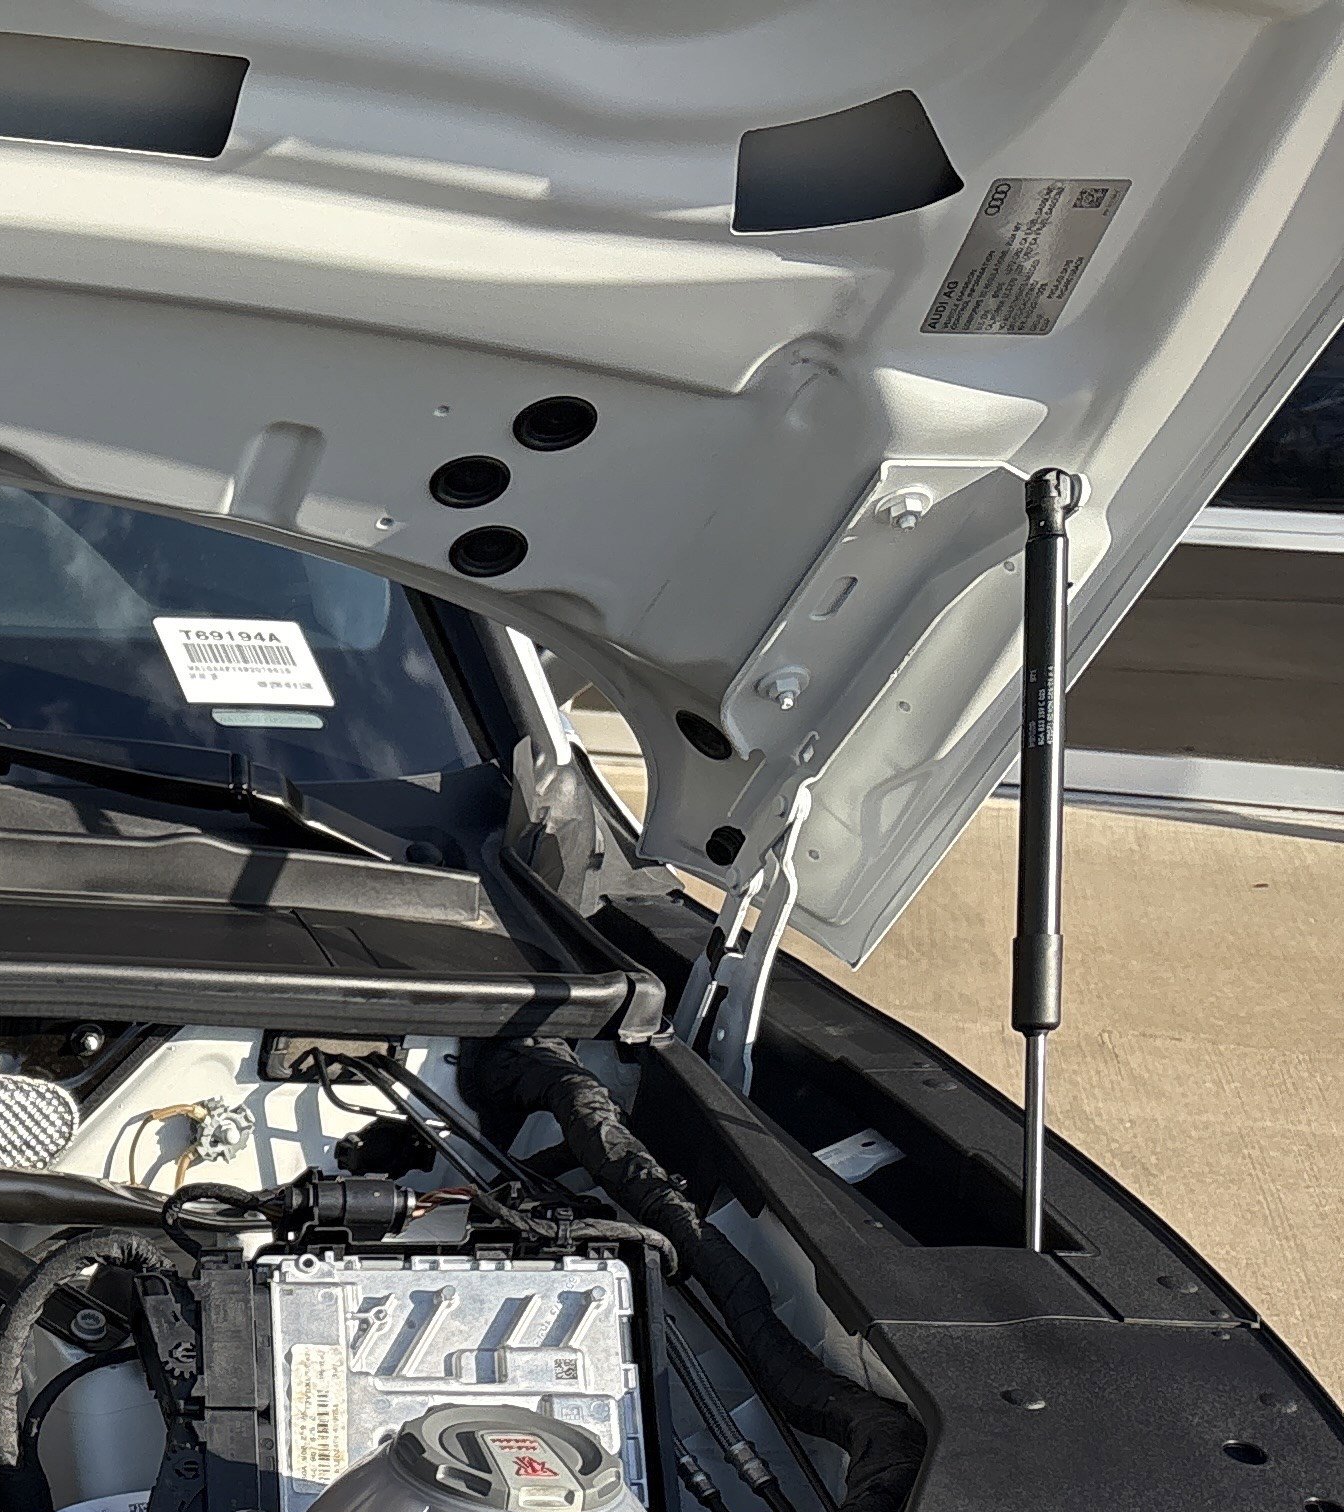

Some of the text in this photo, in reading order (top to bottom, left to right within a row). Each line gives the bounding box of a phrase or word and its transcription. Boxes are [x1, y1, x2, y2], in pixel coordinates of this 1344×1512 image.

[927, 280, 959, 329] AUDI AG
[179, 629, 281, 643] T69194A
